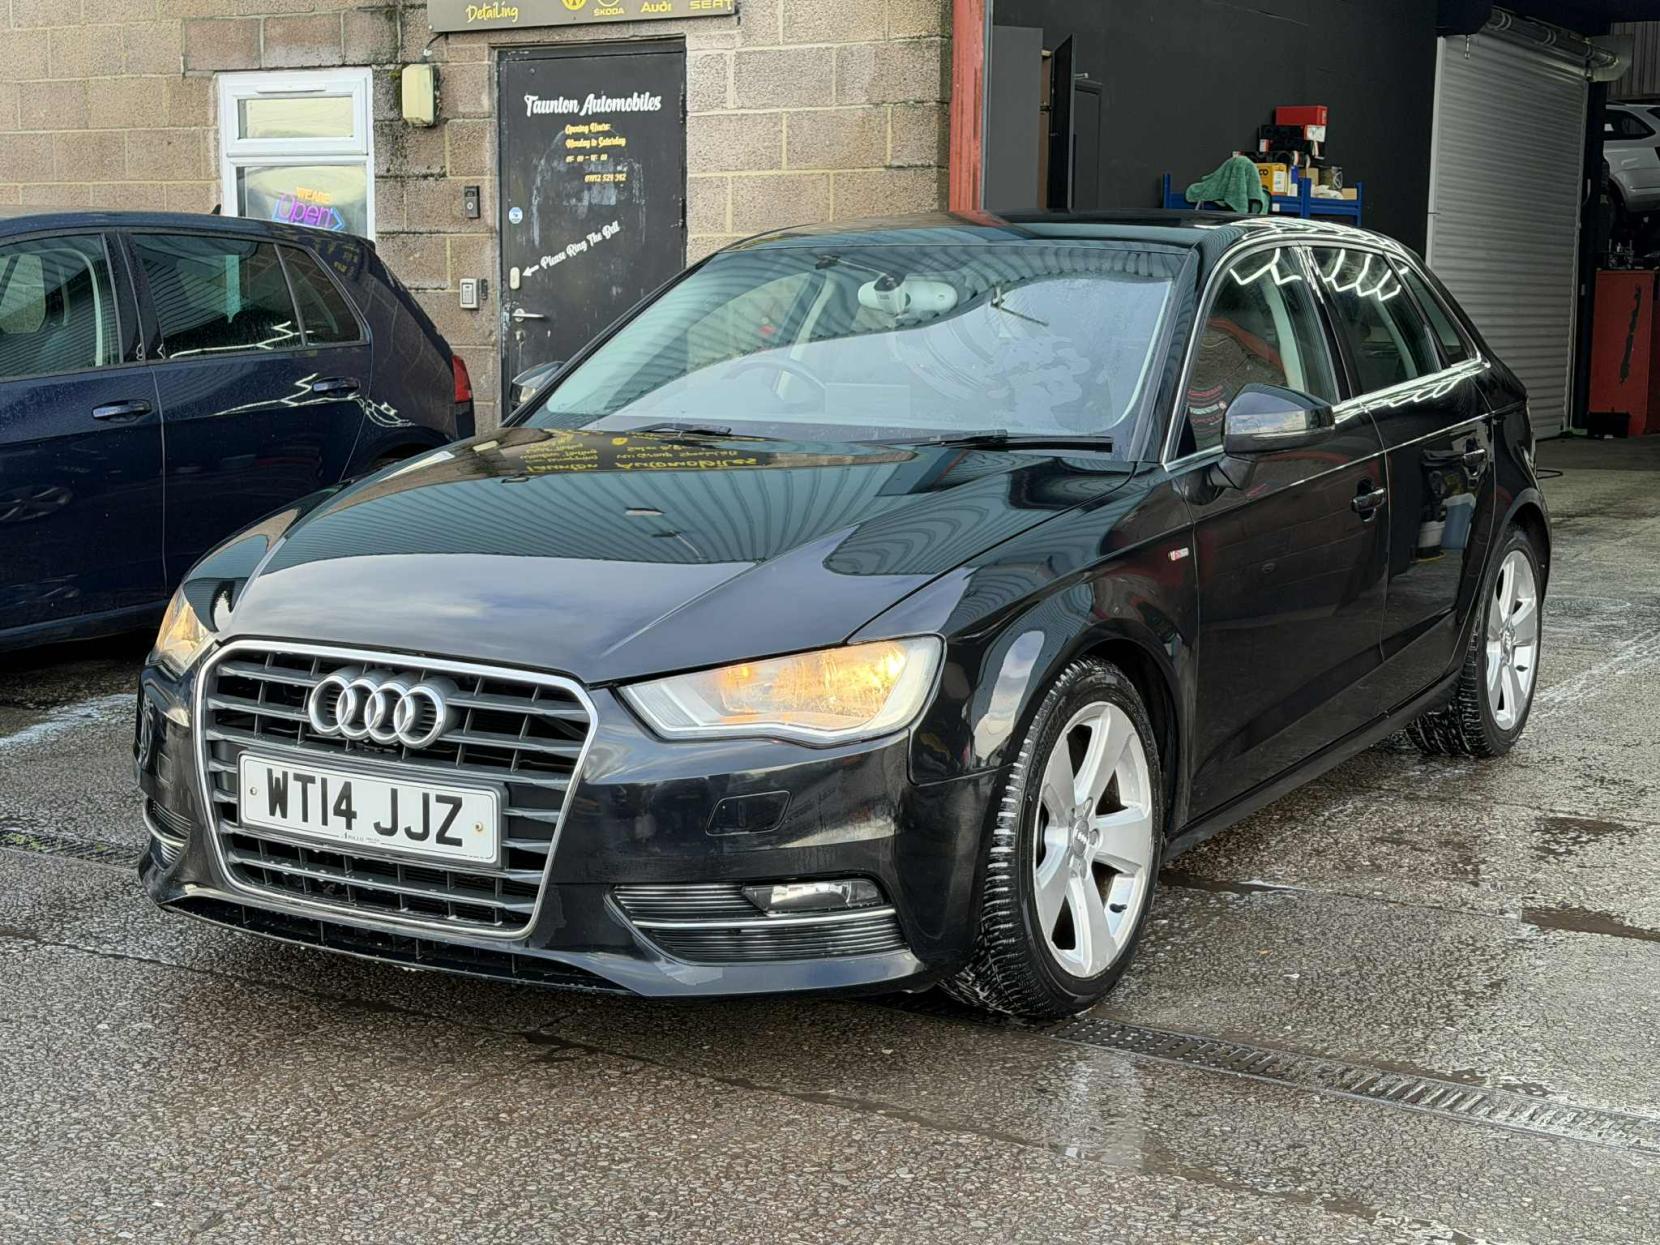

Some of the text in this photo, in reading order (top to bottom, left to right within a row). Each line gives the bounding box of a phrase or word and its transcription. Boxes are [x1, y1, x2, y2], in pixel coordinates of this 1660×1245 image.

[465, 4, 518, 22] Detailing
[640, 2, 672, 13] Audi
[689, 0, 734, 10] SEAT
[524, 92, 662, 117] Taunton Automobiles
[279, 192, 330, 227] Open
[540, 220, 620, 270] Please Ring The Bell
[267, 768, 463, 847] WT14 JJZ
